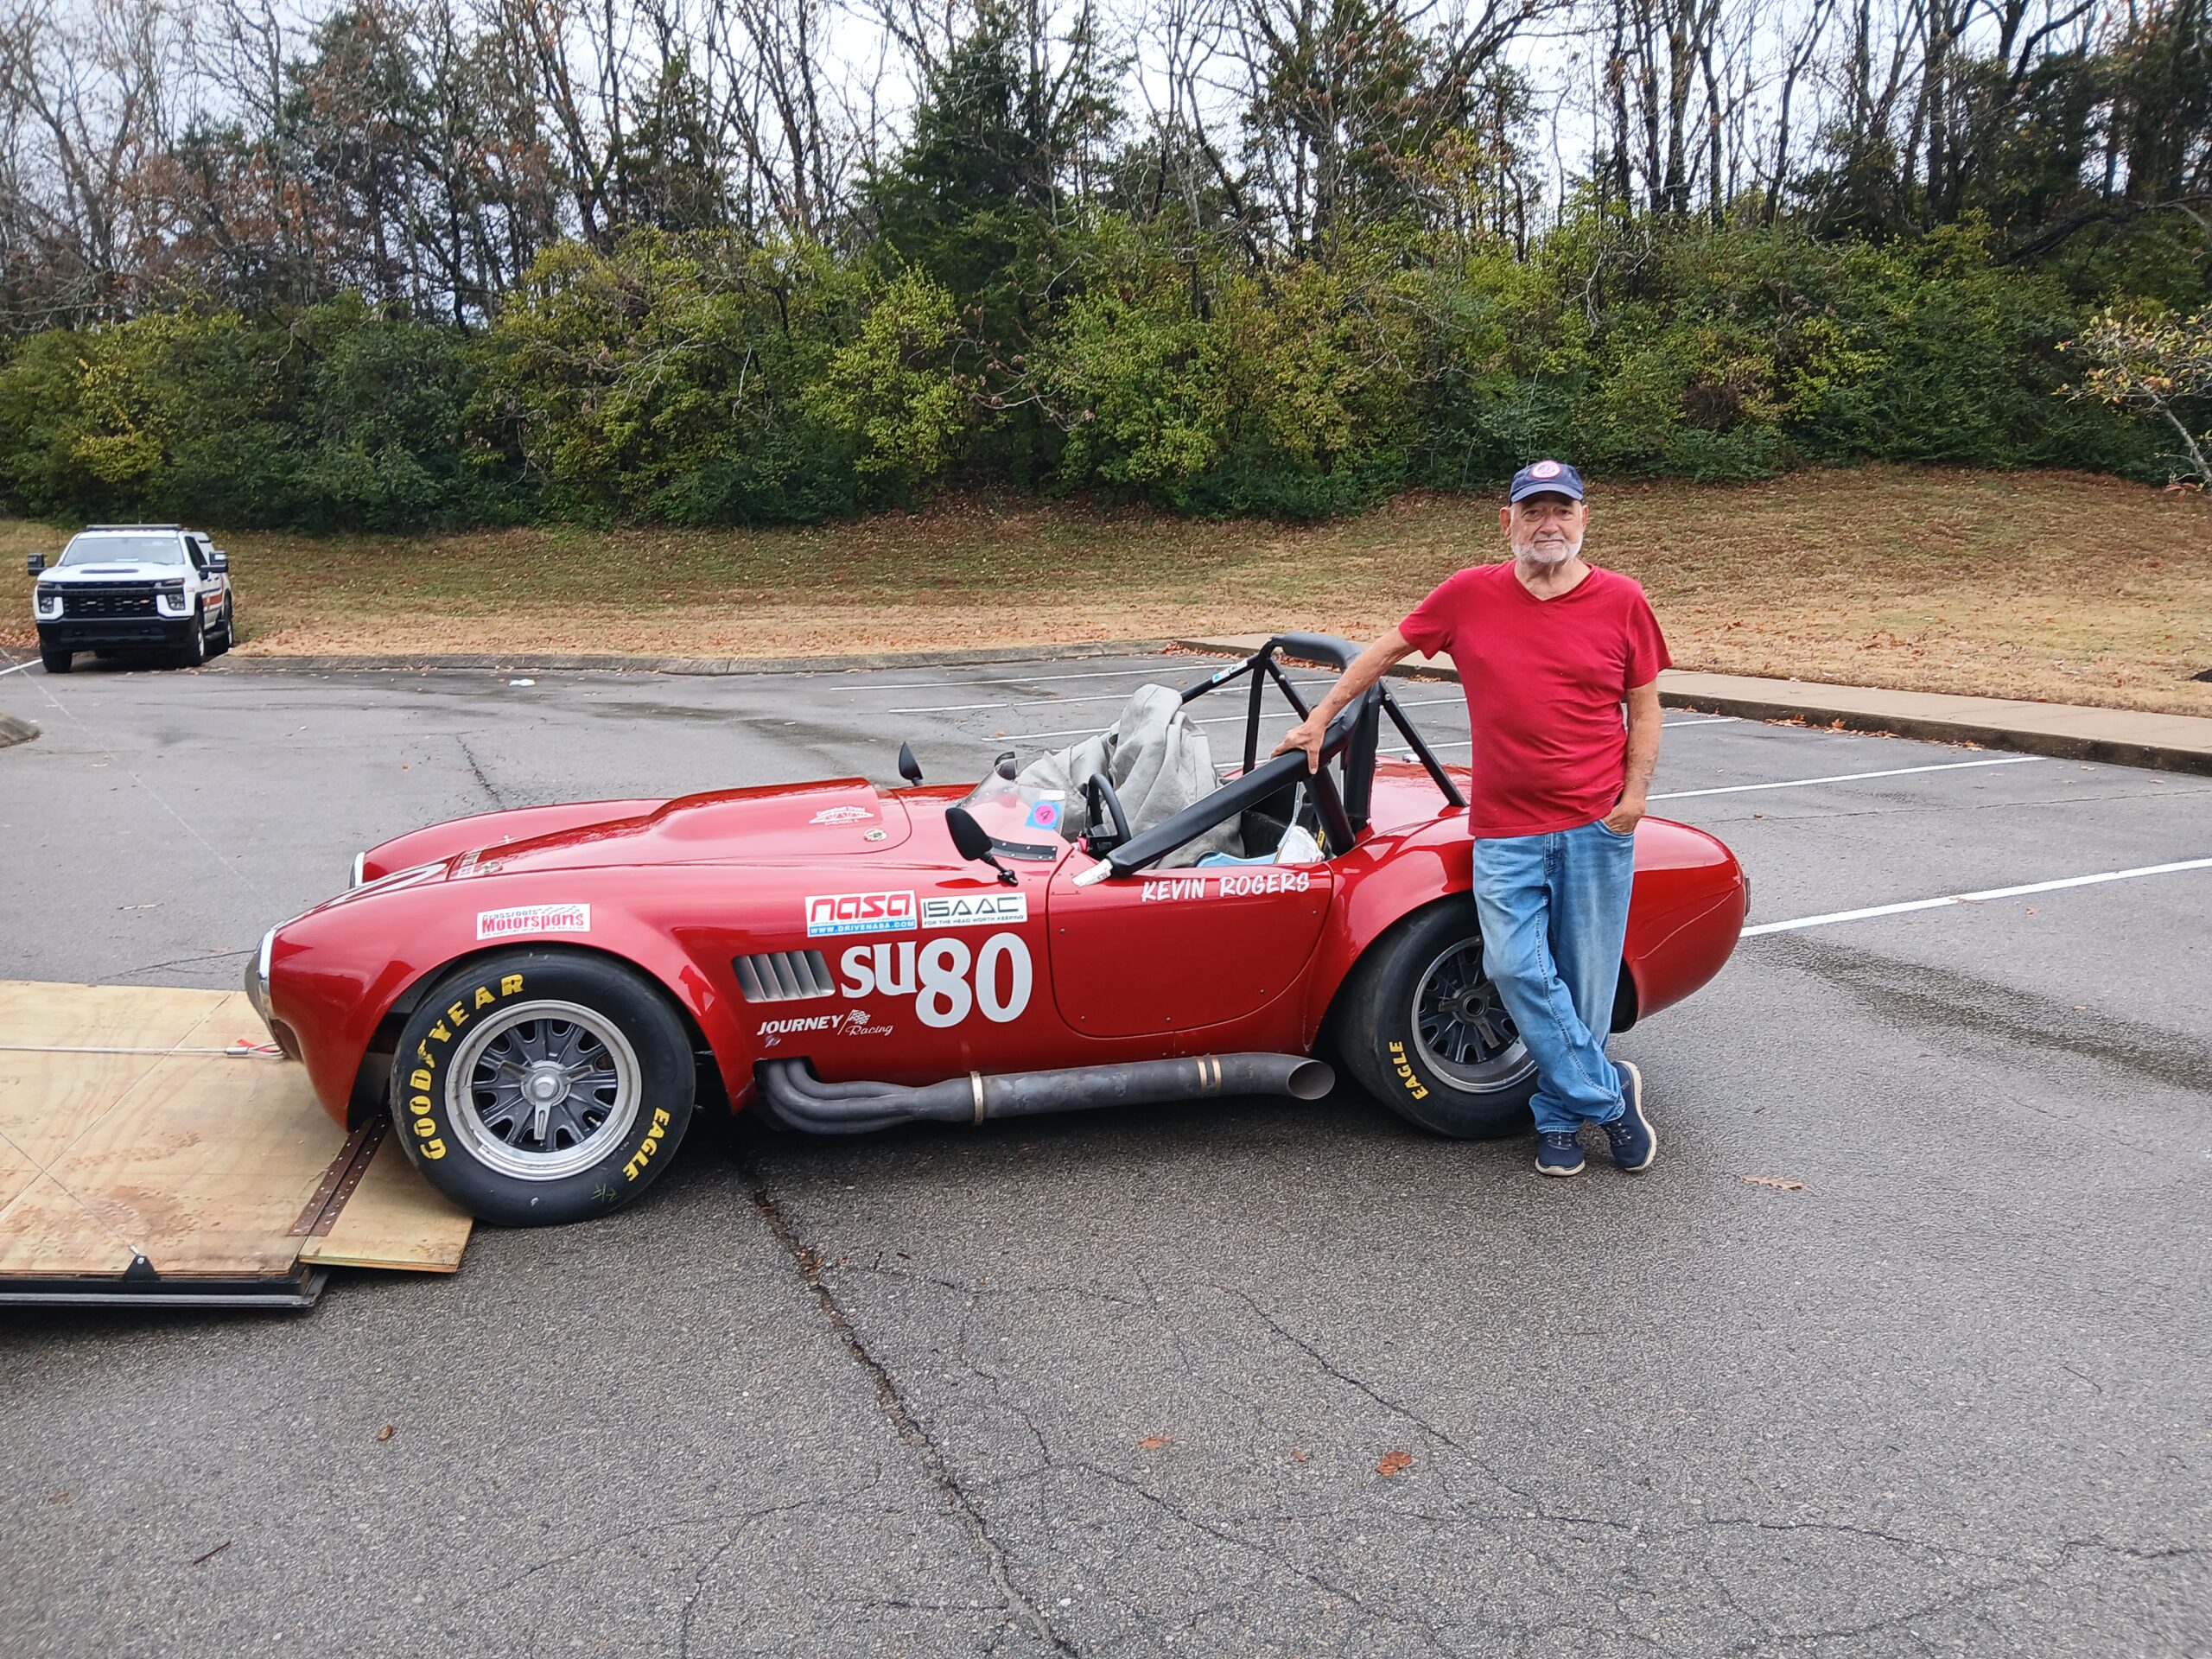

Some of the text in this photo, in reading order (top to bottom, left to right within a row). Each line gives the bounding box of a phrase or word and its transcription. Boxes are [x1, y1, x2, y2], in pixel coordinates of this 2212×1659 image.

[1141, 872, 1310, 902] KEVIN ROGERS
[483, 909, 537, 920] Grassroots
[924, 897, 1019, 918] ISAAC
[482, 913, 583, 933] Motorsports
[810, 921, 915, 934] WWW.DRIVENASA.COM
[757, 1014, 844, 1035] JOURNEY
[845, 1025, 893, 1036] Racing
[409, 973, 524, 1160] GOODYEAR
[1389, 1040, 1428, 1100] EAGLE
[622, 1107, 671, 1182] EAGLE
